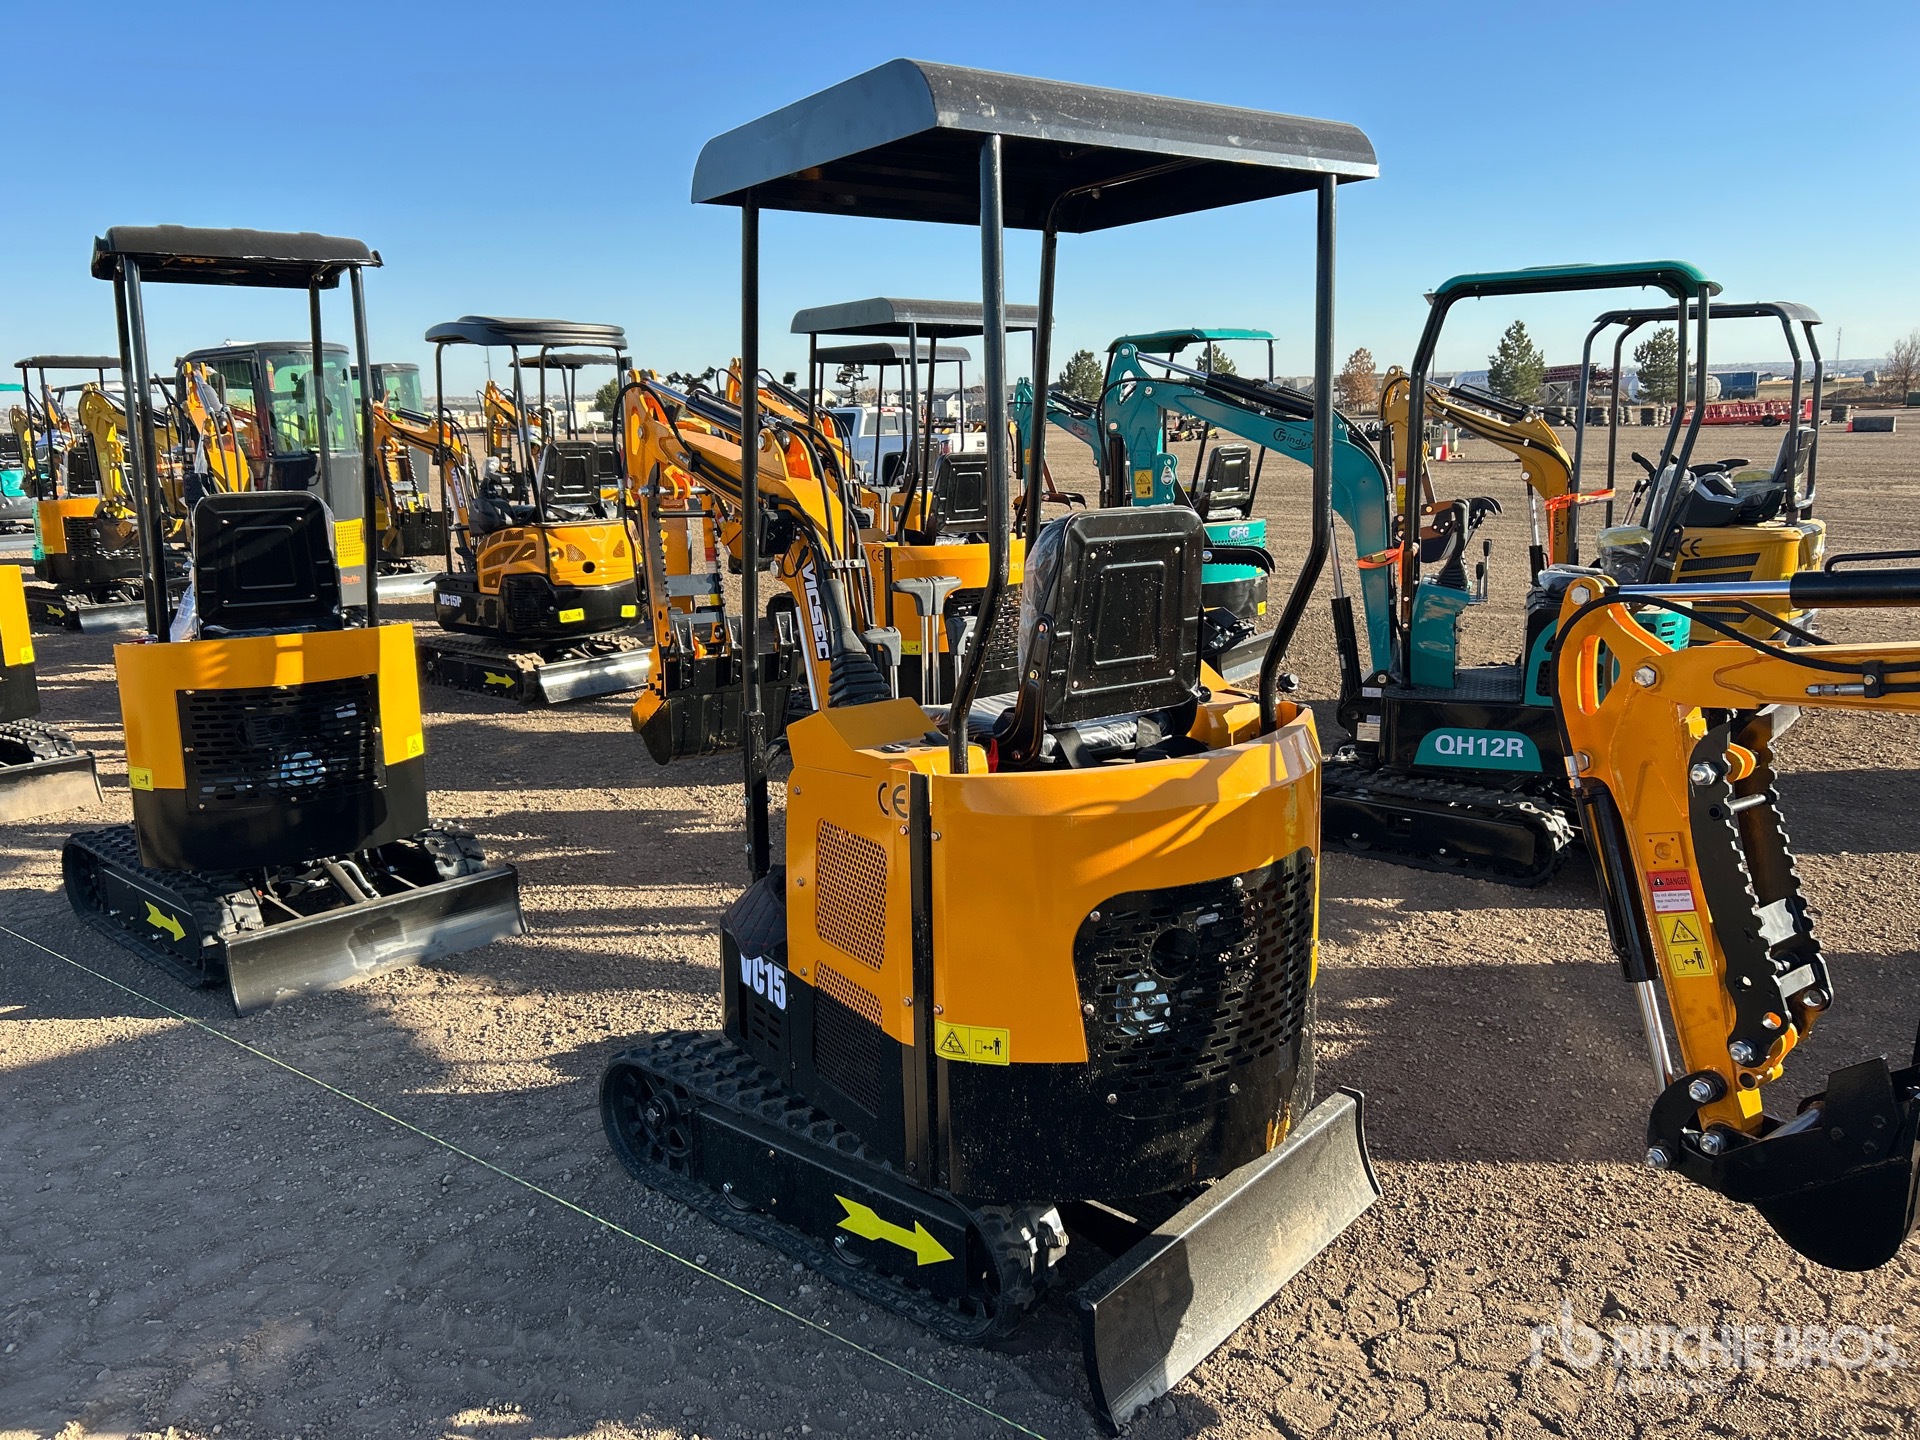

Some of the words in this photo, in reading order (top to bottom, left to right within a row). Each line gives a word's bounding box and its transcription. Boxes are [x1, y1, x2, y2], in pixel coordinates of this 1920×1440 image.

[1229, 526, 1250, 539] CFG
[439, 593, 462, 608] VC15P
[802, 560, 830, 660] VICSEC
[1435, 734, 1524, 758] QH12R
[877, 782, 908, 819] CE
[1665, 876, 1688, 886] DANGER
[740, 953, 787, 1010] VC15
